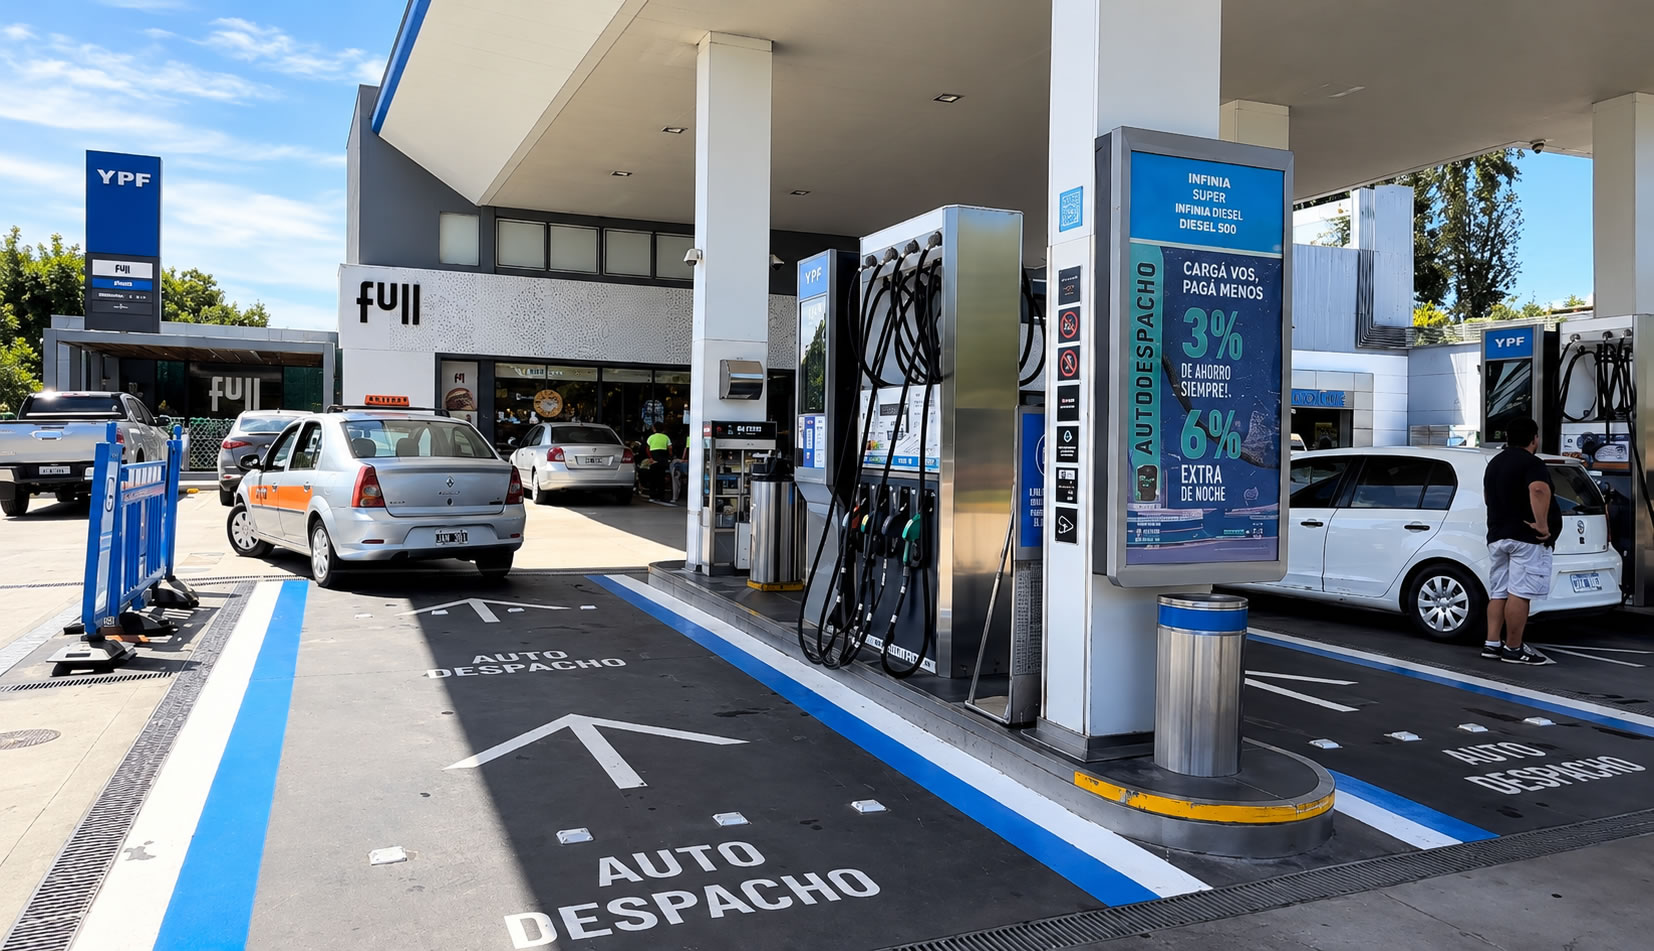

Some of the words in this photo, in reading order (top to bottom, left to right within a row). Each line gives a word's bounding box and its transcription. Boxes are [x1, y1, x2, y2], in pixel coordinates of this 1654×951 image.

[96, 168, 152, 188] YPF
[1188, 172, 1231, 189] INFINIA
[1192, 188, 1226, 204] SUPER
[1175, 202, 1211, 217] INFINIA
[1212, 207, 1244, 221] DIESEL
[1179, 218, 1216, 233] DIESEL
[804, 266, 822, 285] YPF
[1183, 261, 1228, 280] CARGÁ
[1230, 265, 1260, 285] VOS,
[1182, 278, 1217, 297] PAGÁ
[1219, 282, 1264, 300] MENOS
[356, 281, 421, 326] full
[1182, 307, 1243, 361] 3%
[1494, 335, 1526, 349] YPF
[1135, 261, 1156, 456] AUTODESPACHO
[1181, 362, 1195, 379] DE
[1195, 364, 1231, 380] AHORRO
[208, 376, 261, 412] full
[1180, 409, 1242, 460] 6%
[1181, 464, 1222, 484] EXTRA
[1180, 486, 1193, 501] DE
[1195, 486, 1226, 502] NOCHE
[472, 650, 568, 664] AUTO
[425, 658, 626, 679] DESPACHO
[1441, 741, 1546, 765] AUTO
[1463, 756, 1646, 795] DESPACHO
[598, 841, 766, 887] AUTO
[504, 868, 881, 949] DESPACHO
